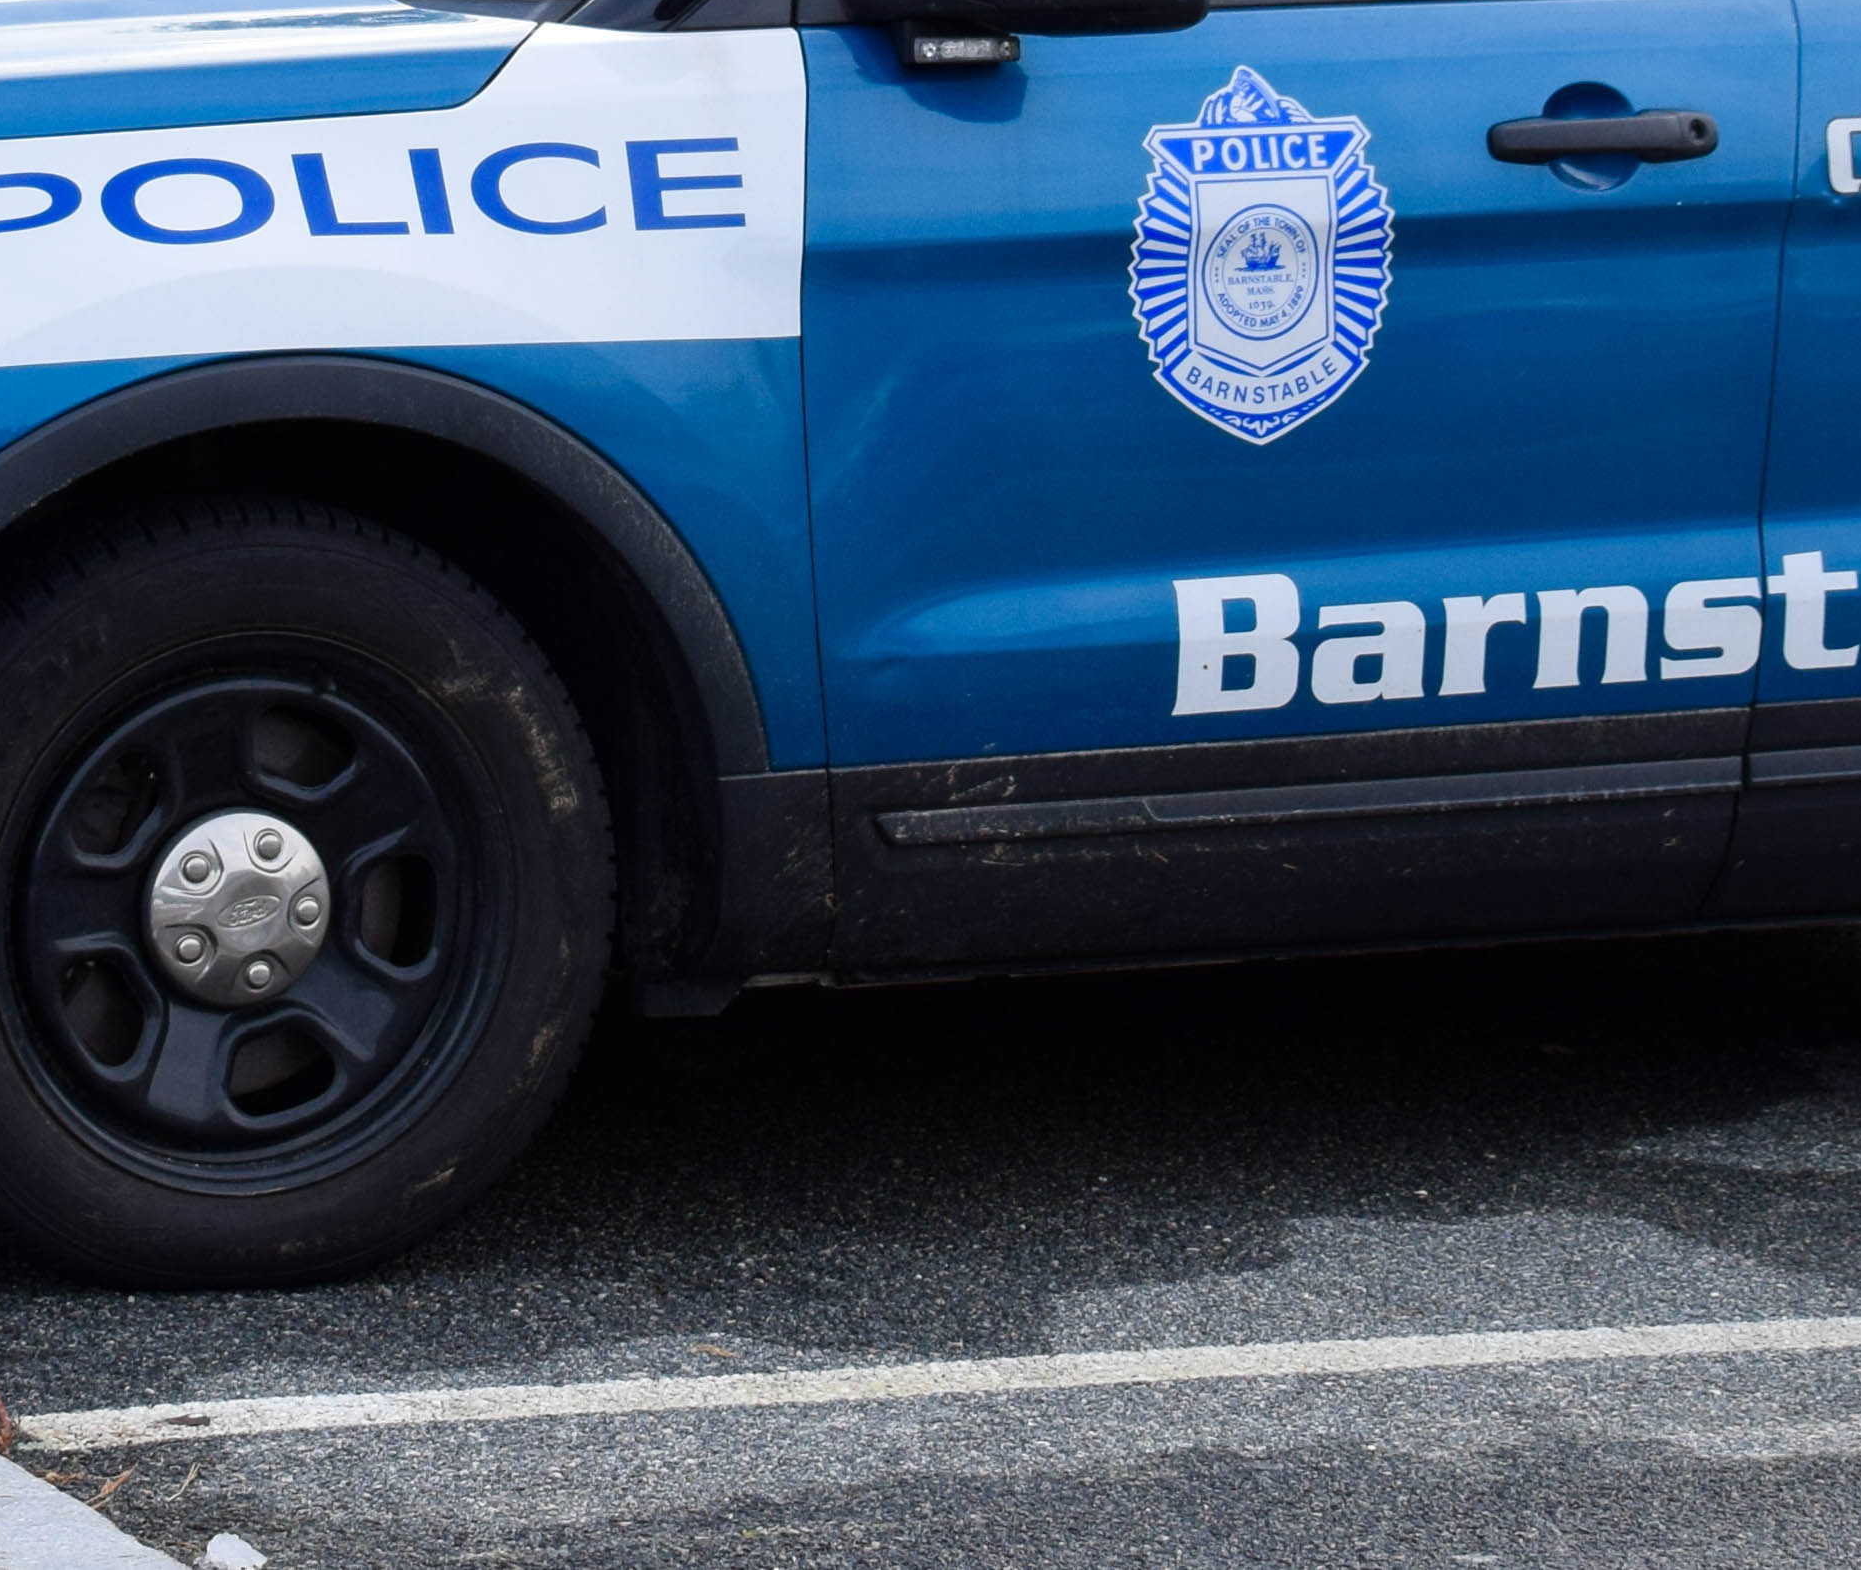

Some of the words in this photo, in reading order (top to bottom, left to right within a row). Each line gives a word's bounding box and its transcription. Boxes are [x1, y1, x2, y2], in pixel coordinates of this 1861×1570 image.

[1193, 135, 1328, 171] POLICE
[1217, 234, 1237, 258] SEAL
[1237, 220, 1251, 235] OF
[1253, 216, 1271, 226] THE
[1275, 218, 1299, 240] TOWN
[1218, 293, 1257, 327] ADOPTED
[1259, 315, 1280, 327] MAY
[1186, 357, 1337, 404] BARNSTABLE
